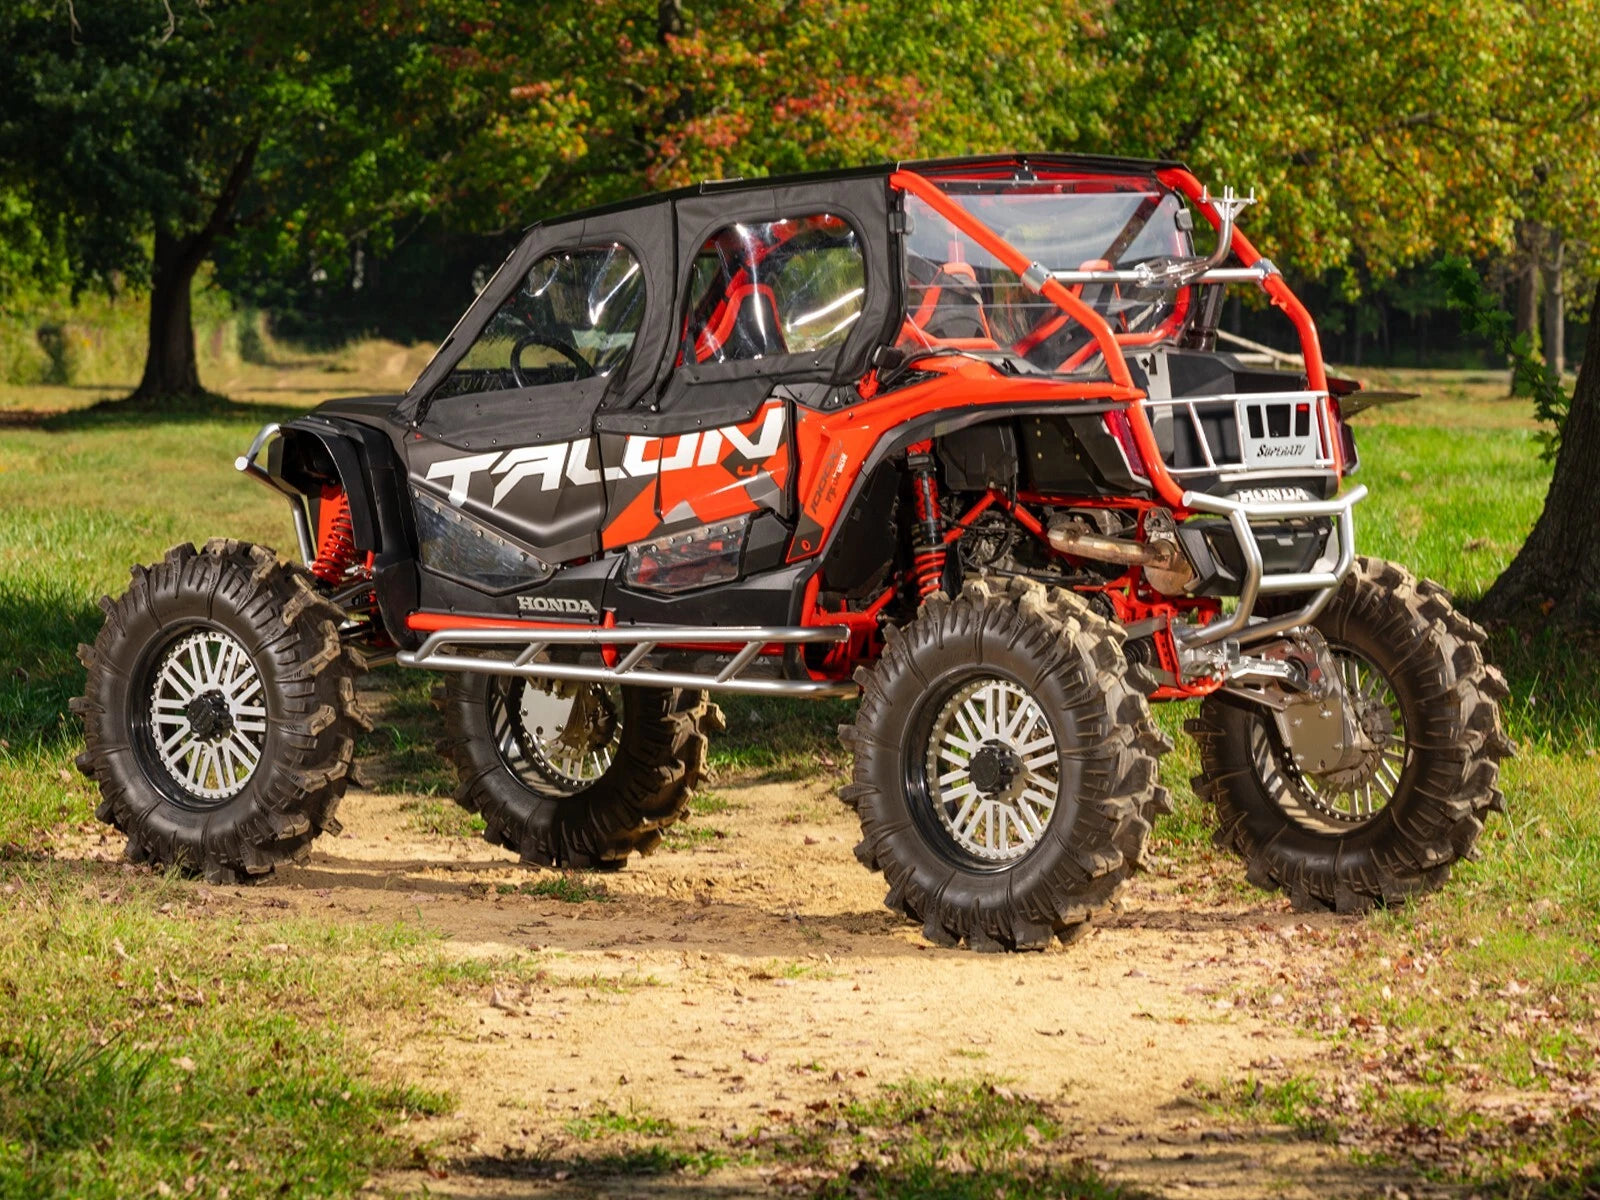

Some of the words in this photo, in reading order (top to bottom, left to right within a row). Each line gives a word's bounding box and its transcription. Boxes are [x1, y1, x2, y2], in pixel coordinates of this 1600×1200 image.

[425, 407, 786, 511] TALON
[1238, 486, 1309, 504] HONDA
[516, 595, 598, 615] HONDA
